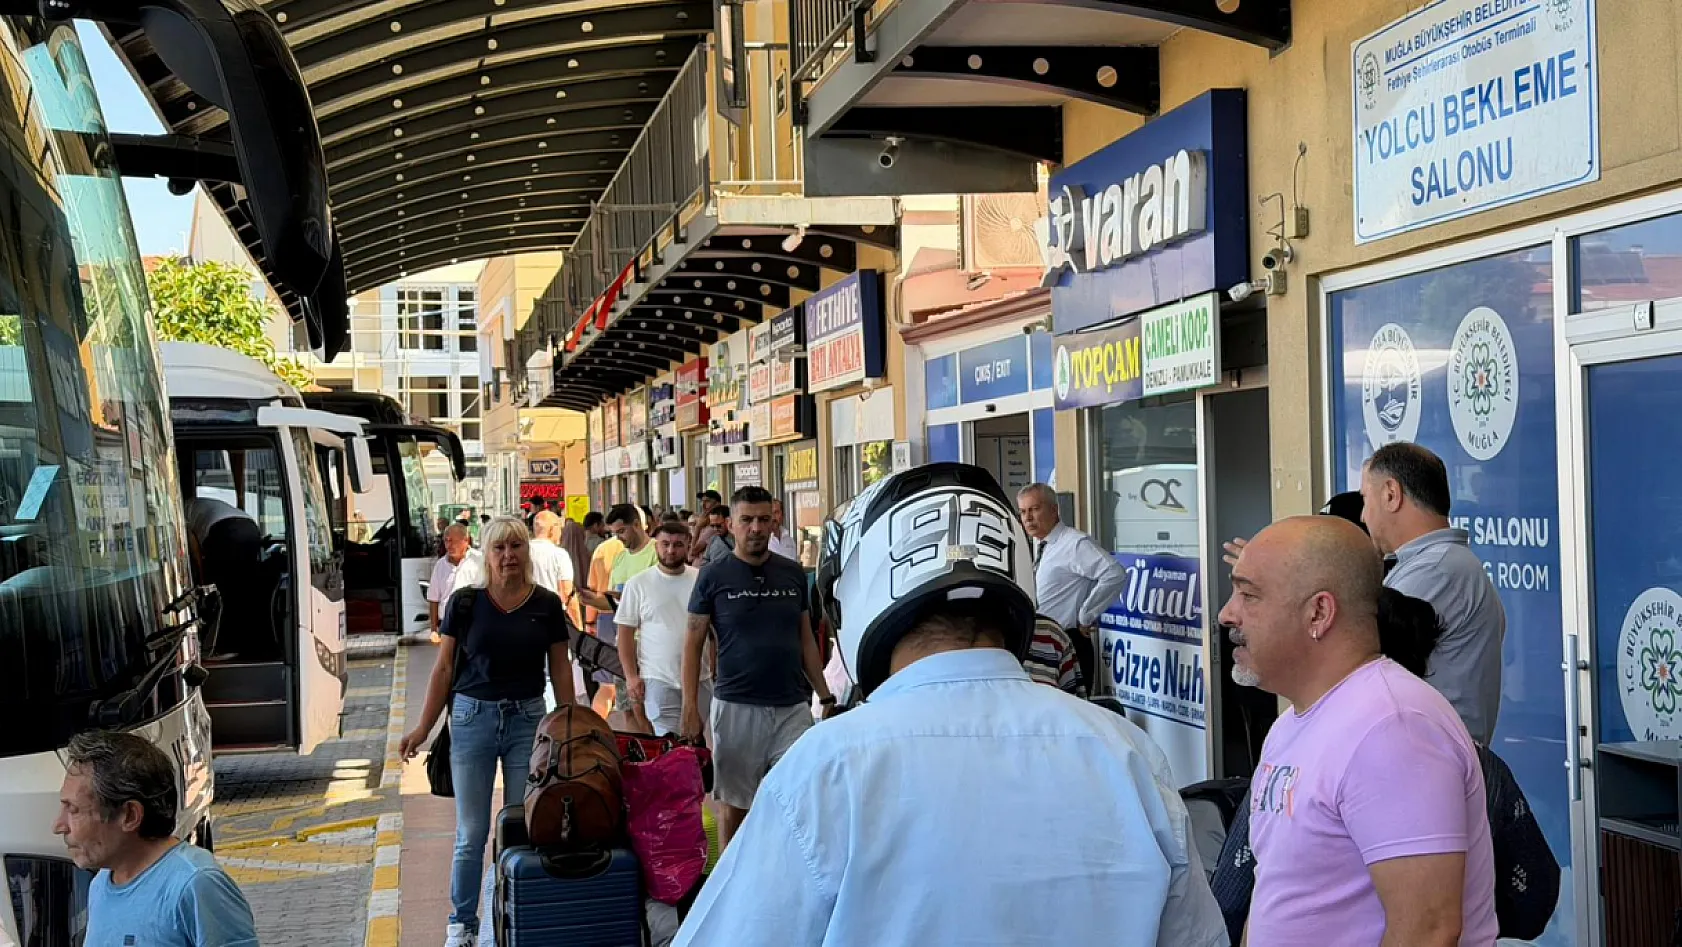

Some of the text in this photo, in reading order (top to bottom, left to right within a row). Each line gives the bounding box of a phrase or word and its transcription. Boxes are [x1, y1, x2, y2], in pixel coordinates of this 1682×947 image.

[1385, 39, 1413, 64] MUĞLA
[1414, 9, 1473, 50] BÜYÜKŞEHİR
[1461, 36, 1492, 59] Otobüs
[1495, 16, 1536, 46] Terminali
[1364, 50, 1577, 164] YOLCU BEKLEME
[1411, 137, 1513, 206] SALONU
[1082, 149, 1193, 270] varan
[1071, 336, 1140, 393] TOPÇAM
[532, 462, 551, 474] WC
[1467, 430, 1499, 450] MUĞLA
[1474, 517, 1549, 547] SALONU
[1122, 559, 1197, 620] Ünal
[1498, 562, 1549, 591] ROOM
[1113, 639, 1204, 704] Cizre Nuh
